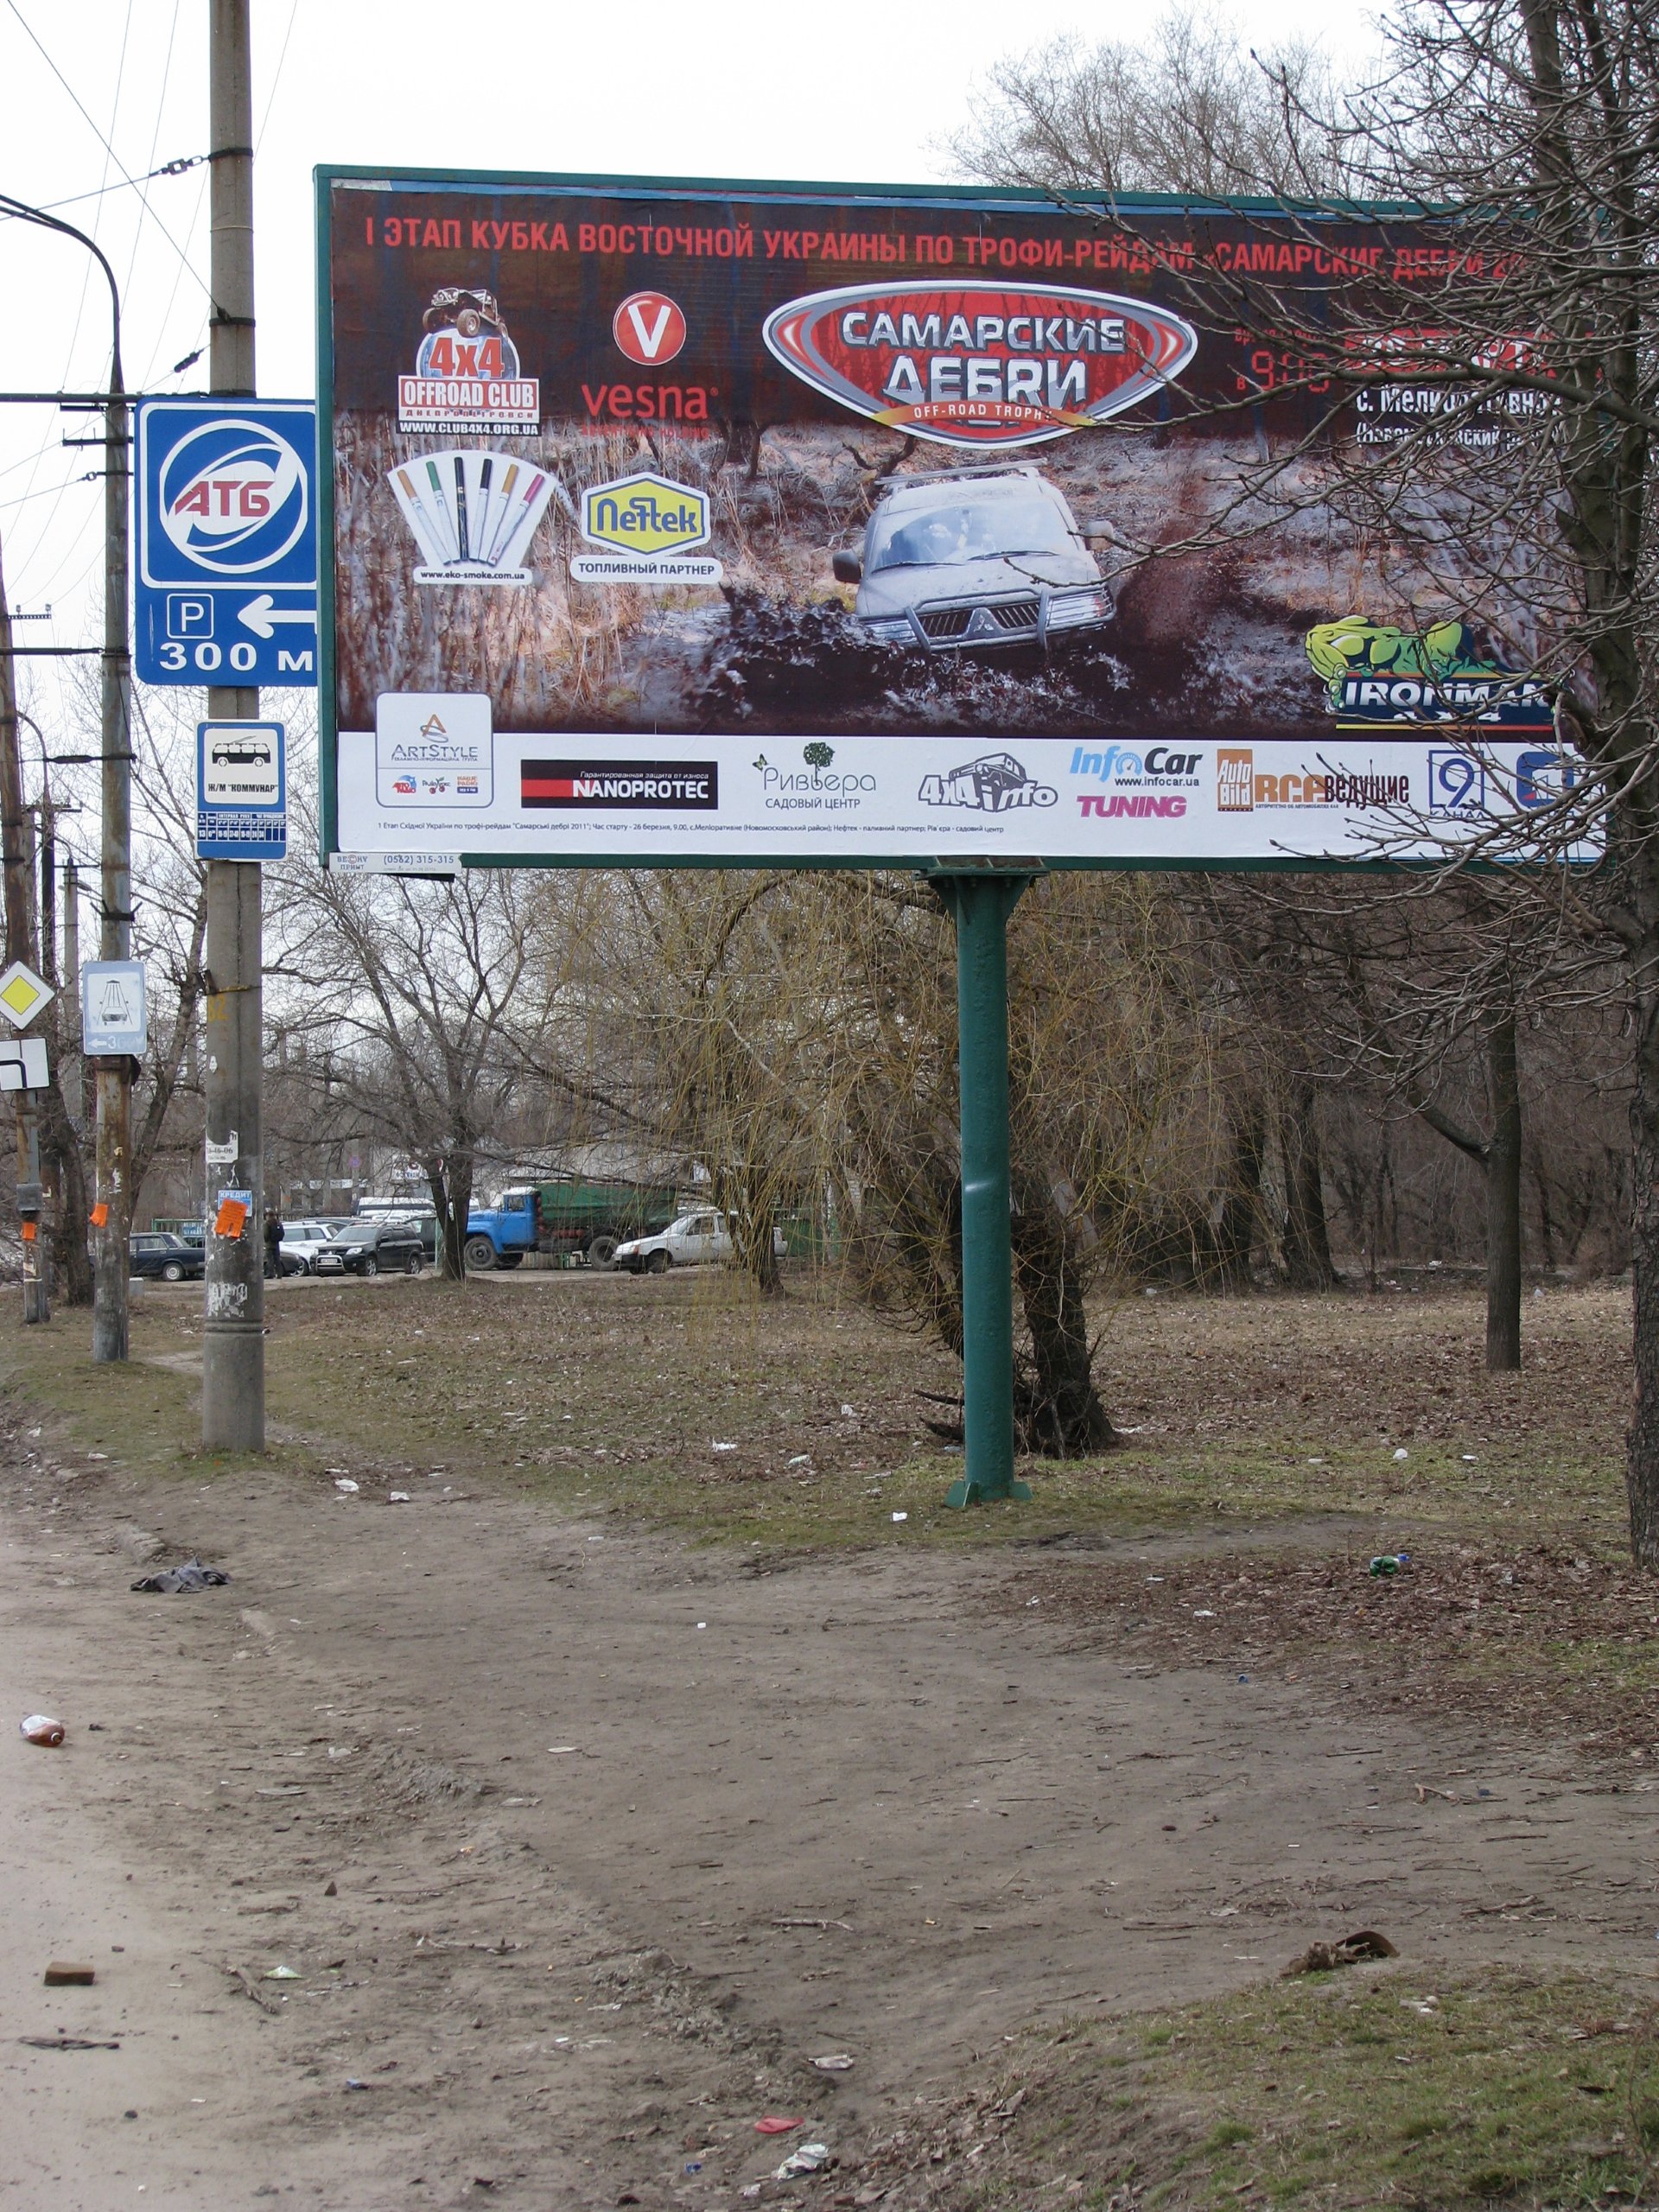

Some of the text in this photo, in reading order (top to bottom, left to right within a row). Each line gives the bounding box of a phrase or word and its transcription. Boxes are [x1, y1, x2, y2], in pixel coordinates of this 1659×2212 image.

[384, 218, 463, 249] ЭТАП
[471, 220, 570, 251] КУБКА
[578, 222, 754, 259] ВОСТОЧНОЙ
[762, 229, 906, 263] УКРАИНЫ
[914, 235, 954, 264] ПО
[842, 311, 1126, 353] САМАРСКИЕ
[404, 380, 535, 409] OFFROAD CLUB
[581, 383, 710, 421] vesna
[913, 403, 988, 419] OFF-ROAD
[399, 422, 539, 435] WWW.CLUB4X4.ORG.UA
[175, 480, 275, 518] АТБ
[597, 497, 698, 533] Neftek
[420, 570, 525, 580] www.eko-smoke.com.ua
[578, 562, 715, 575] ТОПЛИВНЫЙ ПАРТНЕР
[159, 642, 257, 671] 300
[580, 771, 644, 779] Гарантированная
[764, 767, 876, 798] Ривьера
[1115, 777, 1200, 787] www.infocar.ua
[1218, 760, 1252, 784] Auto
[1438, 758, 1475, 808] 9
[207, 783, 226, 792] Ж/М
[573, 779, 709, 799] NANOPROTEC
[1220, 783, 1251, 805] Bild
[766, 797, 861, 810] САДОВЫЙ ЦЕНТР
[1077, 795, 1188, 818] TUNING
[425, 822, 453, 830] України
[955, 824, 983, 833] садовий
[416, 855, 454, 864] 315-315
